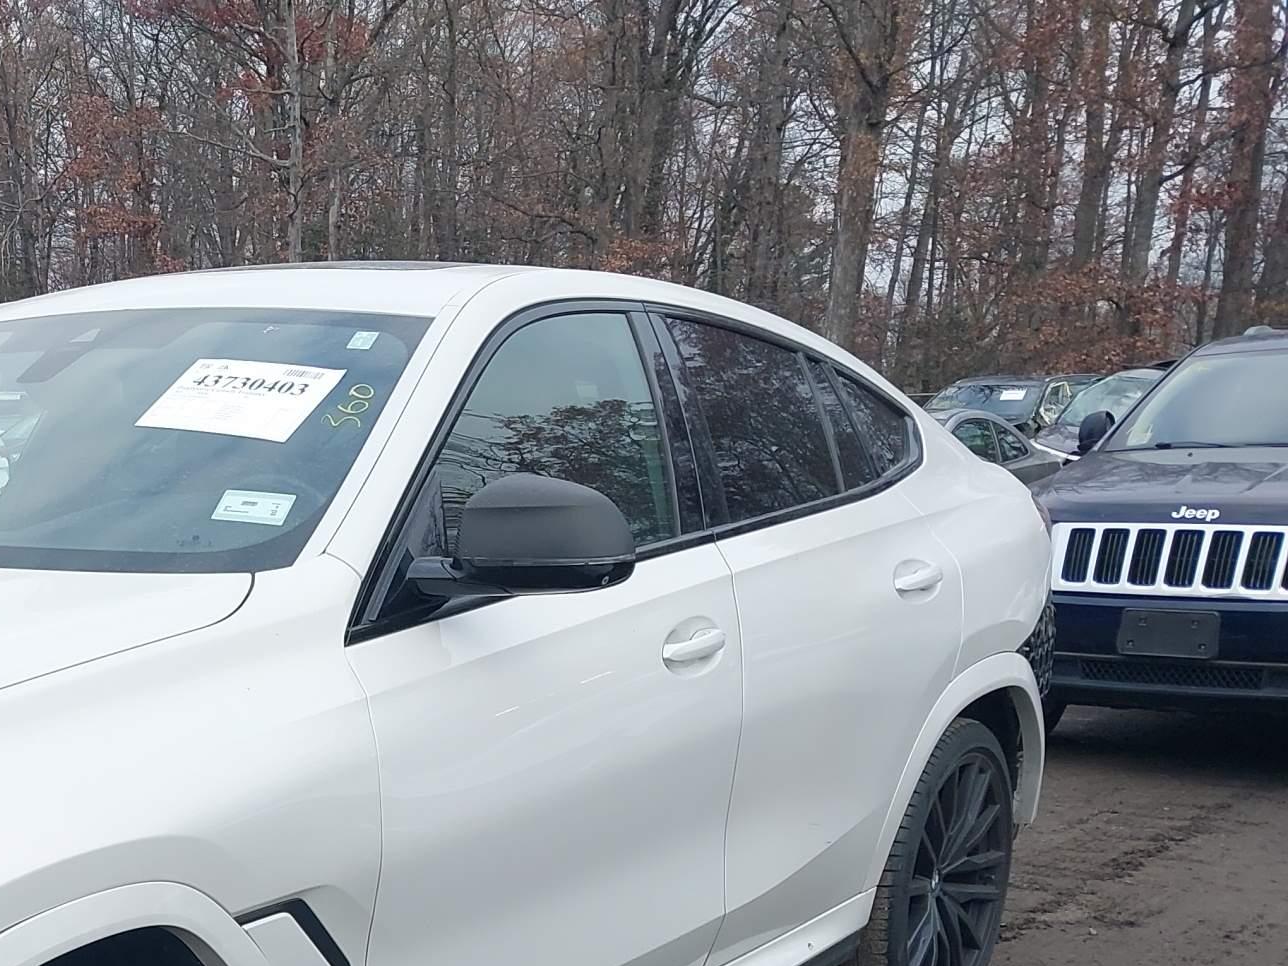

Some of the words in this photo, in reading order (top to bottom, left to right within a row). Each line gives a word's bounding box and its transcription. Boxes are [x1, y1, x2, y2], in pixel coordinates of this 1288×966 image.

[192, 374, 310, 397] 43730403
[321, 383, 375, 428] 360
[1171, 506, 1220, 522] Jeep
